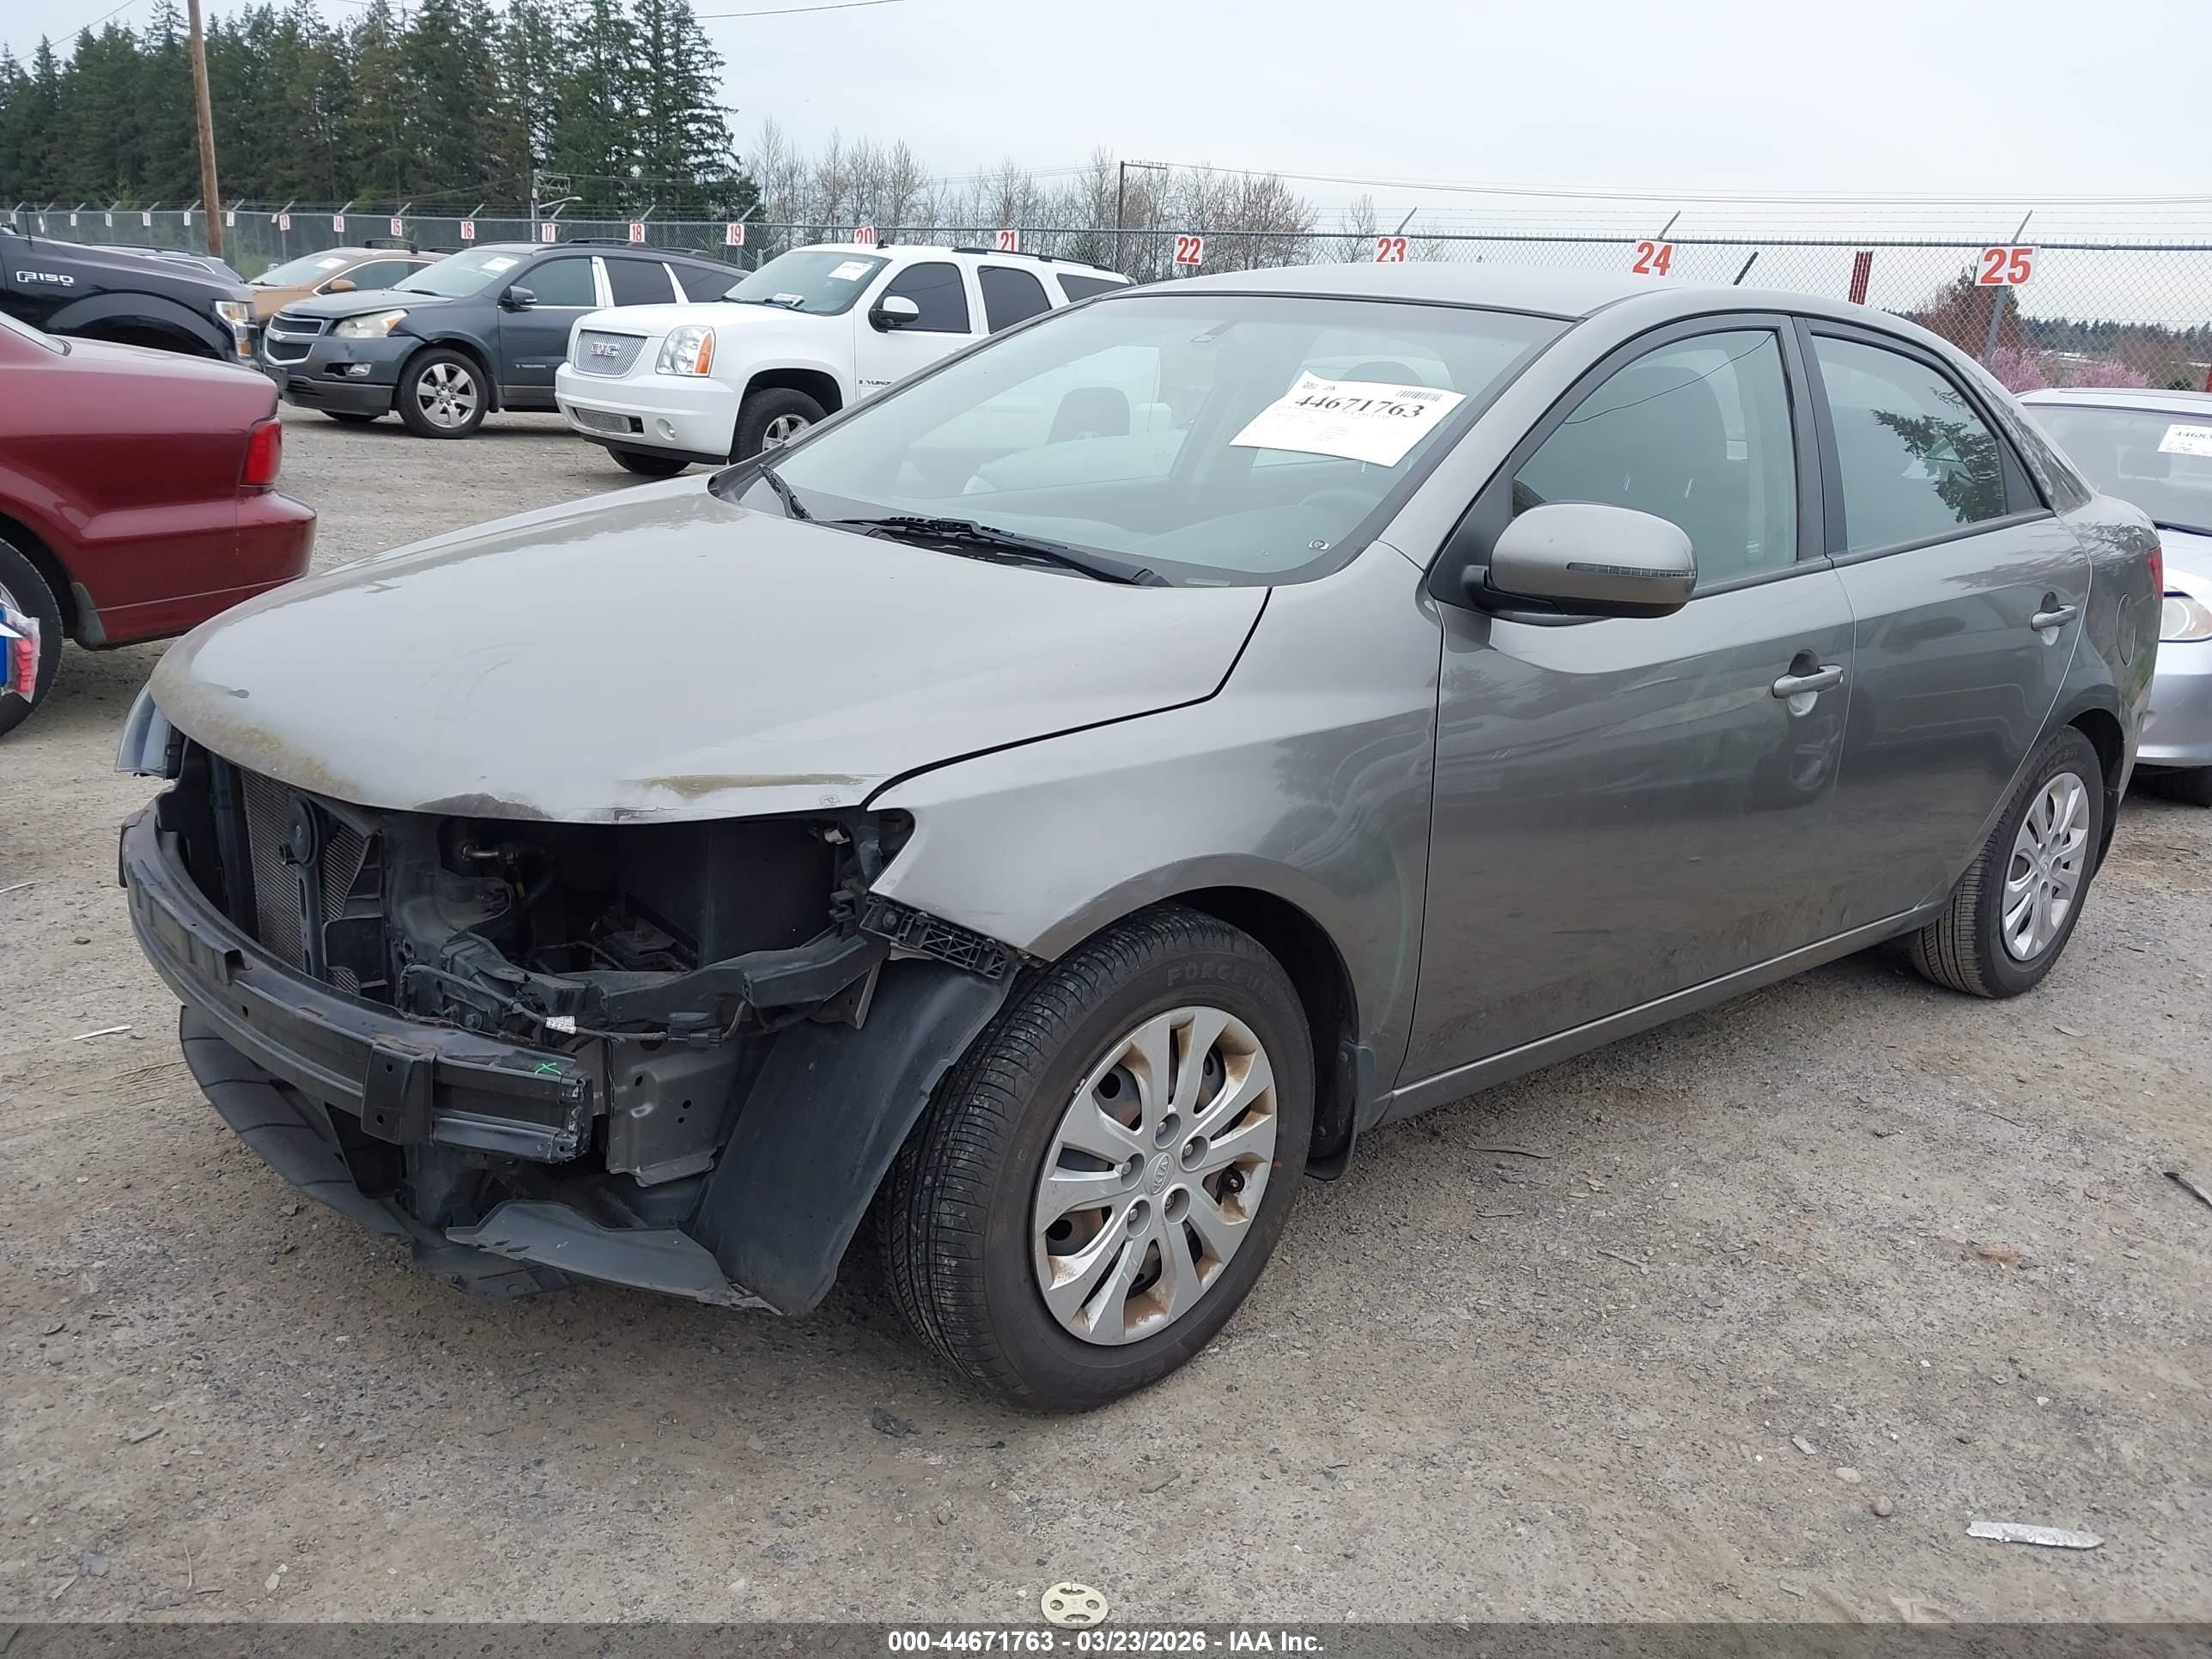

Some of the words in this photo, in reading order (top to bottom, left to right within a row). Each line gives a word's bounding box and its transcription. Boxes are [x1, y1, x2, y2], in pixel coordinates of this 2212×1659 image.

[335, 216, 343, 231] 14
[392, 219, 401, 234] 15
[463, 222, 472, 239] 16
[544, 224, 553, 240] 17
[632, 225, 641, 241] 18
[730, 224, 742, 244] 19
[855, 227, 873, 244] 20
[1000, 231, 1016, 252] 21
[1176, 236, 1201, 264] 22
[1376, 237, 1407, 263] 23
[1632, 242, 1673, 276] 24
[1980, 248, 2033, 284] 25
[1294, 395, 1425, 418] 44671763
[1153, 1157, 1168, 1190] KIA
